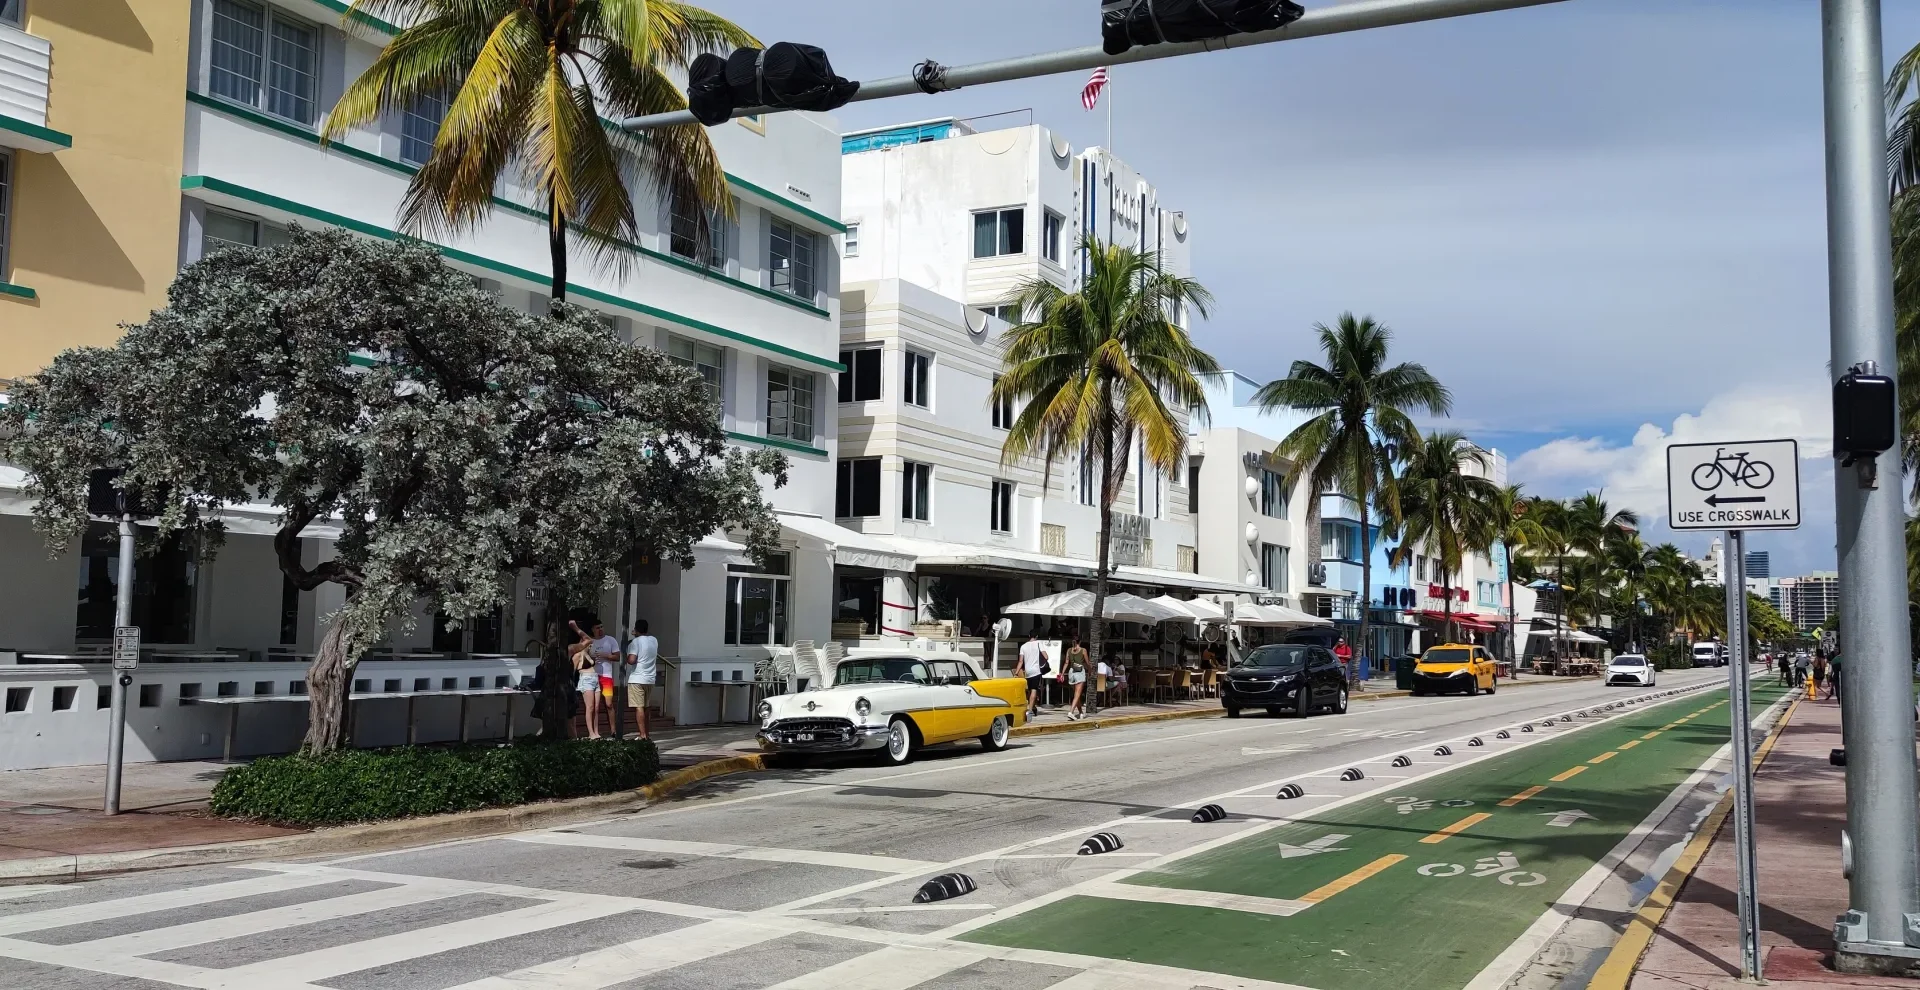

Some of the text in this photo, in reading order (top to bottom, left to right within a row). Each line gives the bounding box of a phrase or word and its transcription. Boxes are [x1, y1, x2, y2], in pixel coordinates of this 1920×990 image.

[1110, 511, 1150, 537] BEACON
[1678, 509, 1790, 523] USE CROSSWALK
